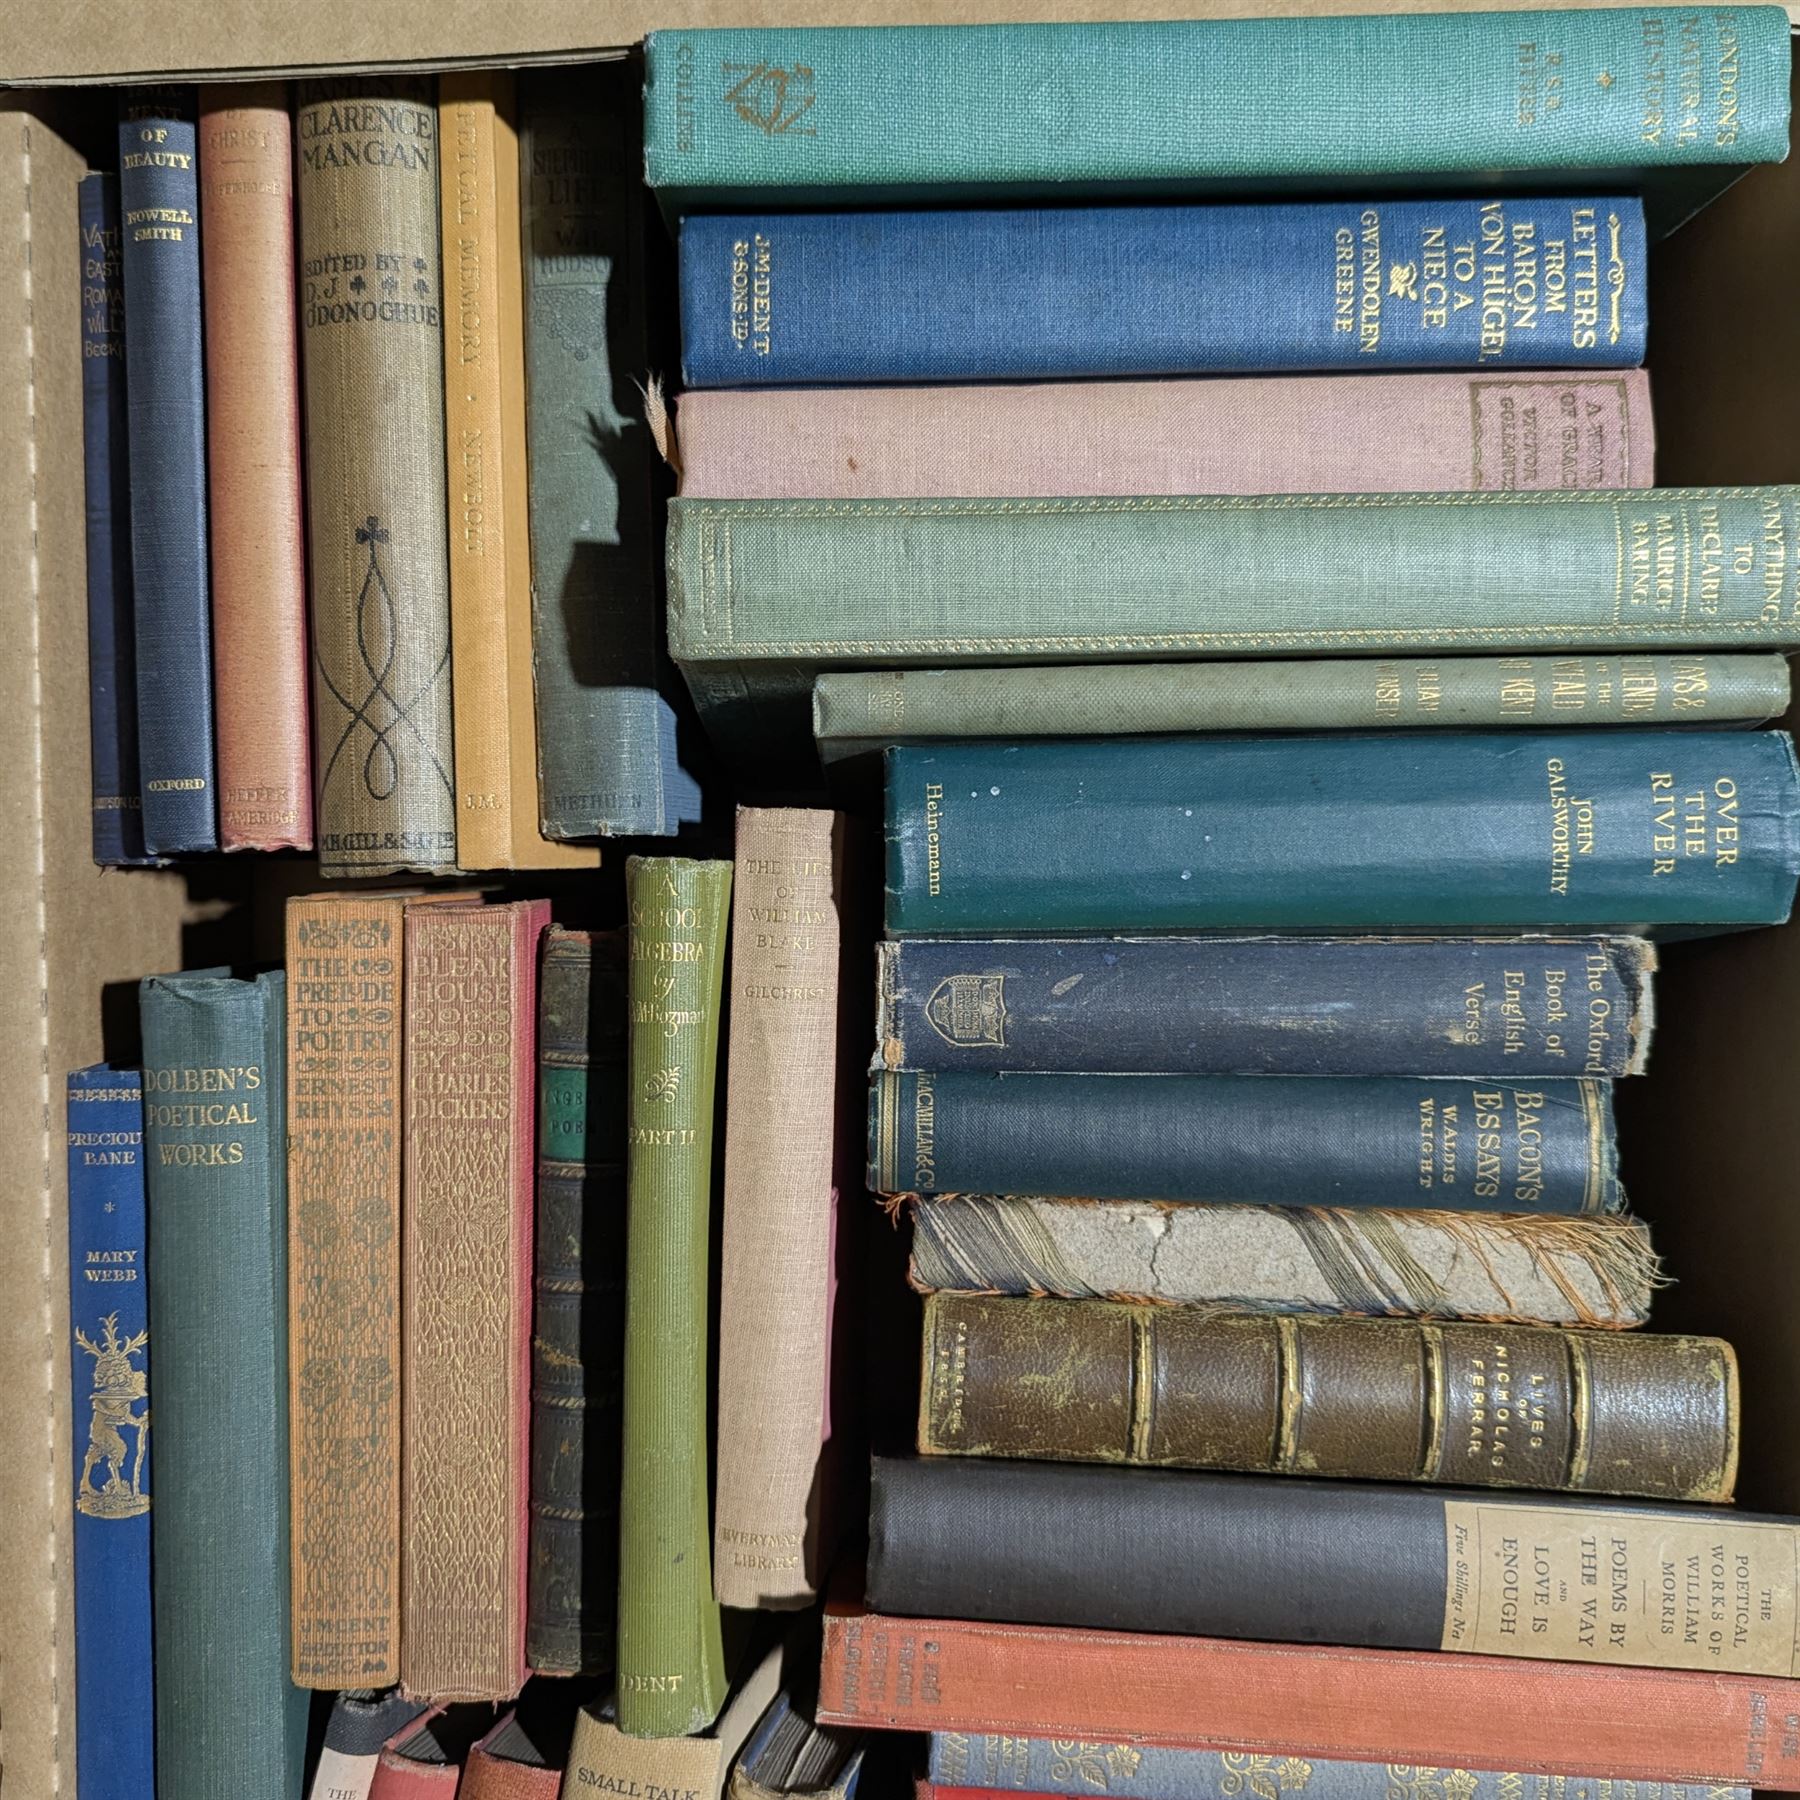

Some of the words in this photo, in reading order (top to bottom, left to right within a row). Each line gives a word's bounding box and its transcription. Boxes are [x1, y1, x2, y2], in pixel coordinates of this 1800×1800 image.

[1640, 17, 1663, 148] HISTORY
[1675, 16, 1699, 148] NATURAL
[1714, 14, 1739, 148] LONDON'S
[141, 129, 168, 145] OF
[302, 104, 432, 141] CLARENCE
[124, 152, 192, 170] BEAUTY
[303, 138, 430, 173] MANGAN
[128, 208, 193, 225] NOWELL
[135, 227, 184, 242] SMITH
[1479, 202, 1506, 256] VON
[305, 254, 367, 278] EDITED
[376, 253, 406, 271] BY
[1333, 228, 1354, 332] GREENE
[1359, 210, 1381, 353] GWENDOLEN
[1421, 227, 1446, 328] NIECE
[1453, 242, 1477, 281] TO
[1512, 223, 1536, 330] BARON
[1543, 240, 1566, 313] FROM
[1571, 208, 1598, 348] LETTERS
[456, 240, 481, 368] MEMORY
[1453, 291, 1475, 312] A
[1478, 265, 1513, 361] HÜGEL
[1561, 393, 1577, 418] OF
[1585, 402, 1602, 417] A
[1523, 407, 1537, 482] VICTOR
[1582, 425, 1604, 488] YEAR
[1631, 520, 1651, 606] BARING
[1655, 514, 1677, 612] MAURICE
[1698, 505, 1722, 616] DECLARE?
[1733, 543, 1754, 575] TO
[1760, 498, 1785, 624] ANYTHING
[1497, 679, 1537, 718] KENT
[147, 778, 205, 792] OXFORD
[926, 783, 944, 897] Heinemann
[1545, 756, 1571, 897] GALSWORTHY
[1570, 797, 1594, 855] JOHN
[1649, 772, 1676, 878] RIVER
[1684, 791, 1706, 858] THE
[1713, 777, 1739, 869] OVER
[657, 873, 679, 897] A
[745, 859, 781, 875] THE
[749, 907, 828, 924] WILLIAM
[631, 941, 705, 963] ALGEBRA
[756, 934, 817, 950] BLAKE
[653, 964, 677, 1001] by
[745, 985, 826, 1001] GILCHRIST
[1545, 970, 1568, 1024] Book
[1585, 952, 1609, 992] The
[1464, 983, 1486, 1046] Verse
[1500, 970, 1526, 1056] English
[1584, 998, 1611, 1073] Oxford
[1545, 1035, 1565, 1056] of
[144, 1065, 262, 1093] DOLBEN'S
[147, 1102, 258, 1128] POETICAL
[629, 1128, 676, 1146] PART
[85, 1150, 136, 1166] BANE
[158, 1141, 244, 1167] WORKS
[1418, 1097, 1435, 1189] WRIGHT
[1472, 1090, 1505, 1198] ESSAYS
[1512, 1090, 1544, 1201] BACON'S
[84, 1268, 138, 1283] WEBB
[86, 1249, 138, 1264] MARY
[1490, 1345, 1510, 1467] NICHOLAS
[1529, 1374, 1545, 1449] LIVES
[734, 1553, 799, 1571] LIBRARY
[1453, 1523, 1469, 1556] Five
[1579, 1535, 1598, 1586] THE
[1450, 1560, 1469, 1613] Shillings
[1499, 1536, 1520, 1636] ENOUGH
[1533, 1545, 1550, 1607] LOVE
[1558, 1579, 1568, 1603] AND
[1609, 1536, 1628, 1613] POEMS
[1659, 1561, 1676, 1636] MORRIS
[1682, 1555, 1700, 1645] WILLIAM
[1709, 1543, 1725, 1622] WORKS
[1531, 1616, 1549, 1634] IS
[1577, 1598, 1597, 1649] WAY
[1732, 1554, 1750, 1649] POETICAL
[1759, 1588, 1773, 1622] THE
[1451, 1617, 1467, 1641] Net
[1607, 1622, 1626, 1649] BY
[1706, 1631, 1722, 1657] OF
[620, 1672, 682, 1694] DENT
[327, 1787, 358, 1800] THE
[577, 1766, 641, 1798] SMALL
[644, 1783, 702, 1800] TALK
